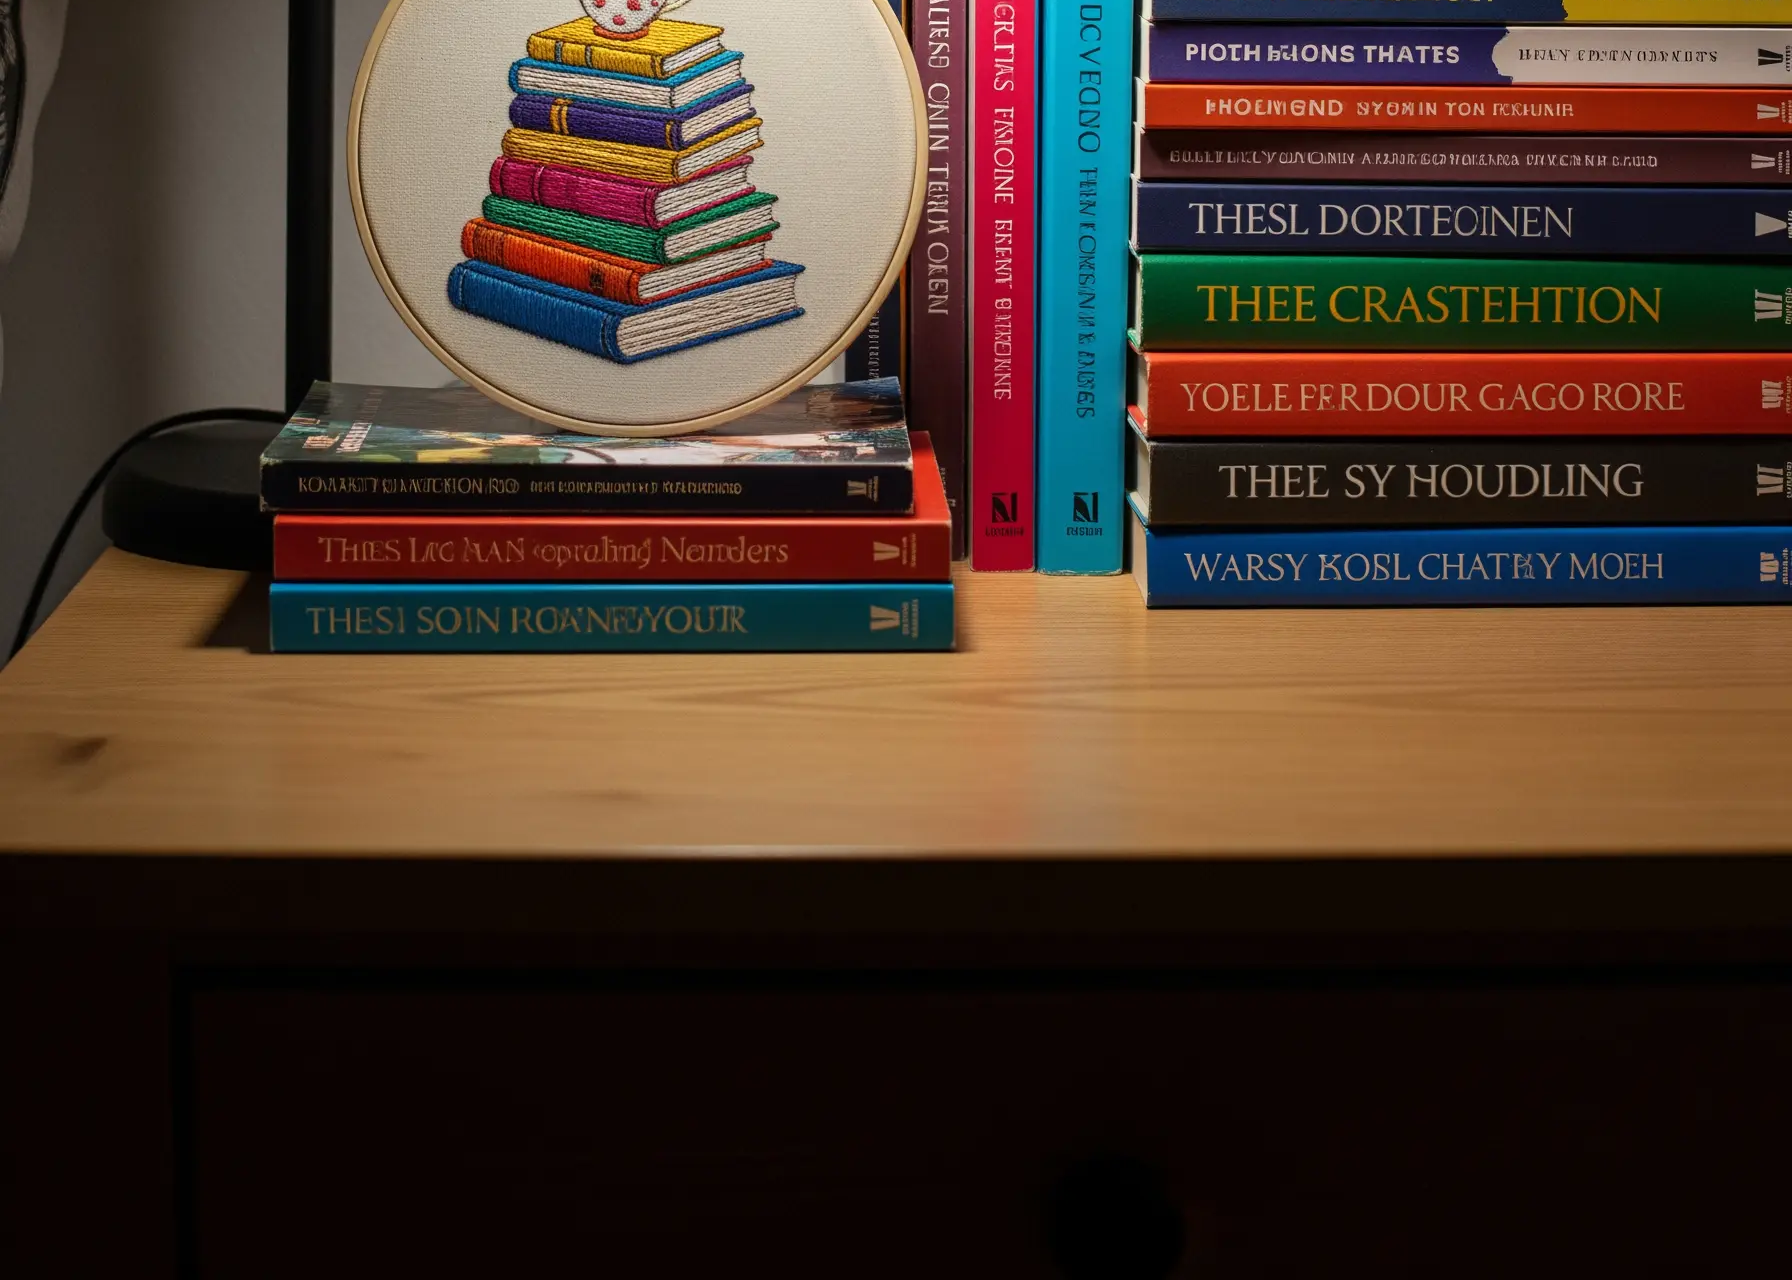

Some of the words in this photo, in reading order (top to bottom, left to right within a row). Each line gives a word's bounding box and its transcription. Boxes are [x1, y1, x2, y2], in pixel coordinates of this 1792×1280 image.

[1188, 202, 1308, 235] THESL
[1196, 285, 1316, 322] THEE
[1329, 285, 1662, 324] CRASTEHTION
[1479, 382, 1585, 412] GAGO
[1592, 381, 1685, 412] RORE
[1218, 464, 1330, 498] THEE
[1344, 464, 1396, 499] SY
[1405, 463, 1644, 499] HOUDLING
[1184, 552, 1308, 581] WARSY
[416, 605, 501, 635] SOIN
